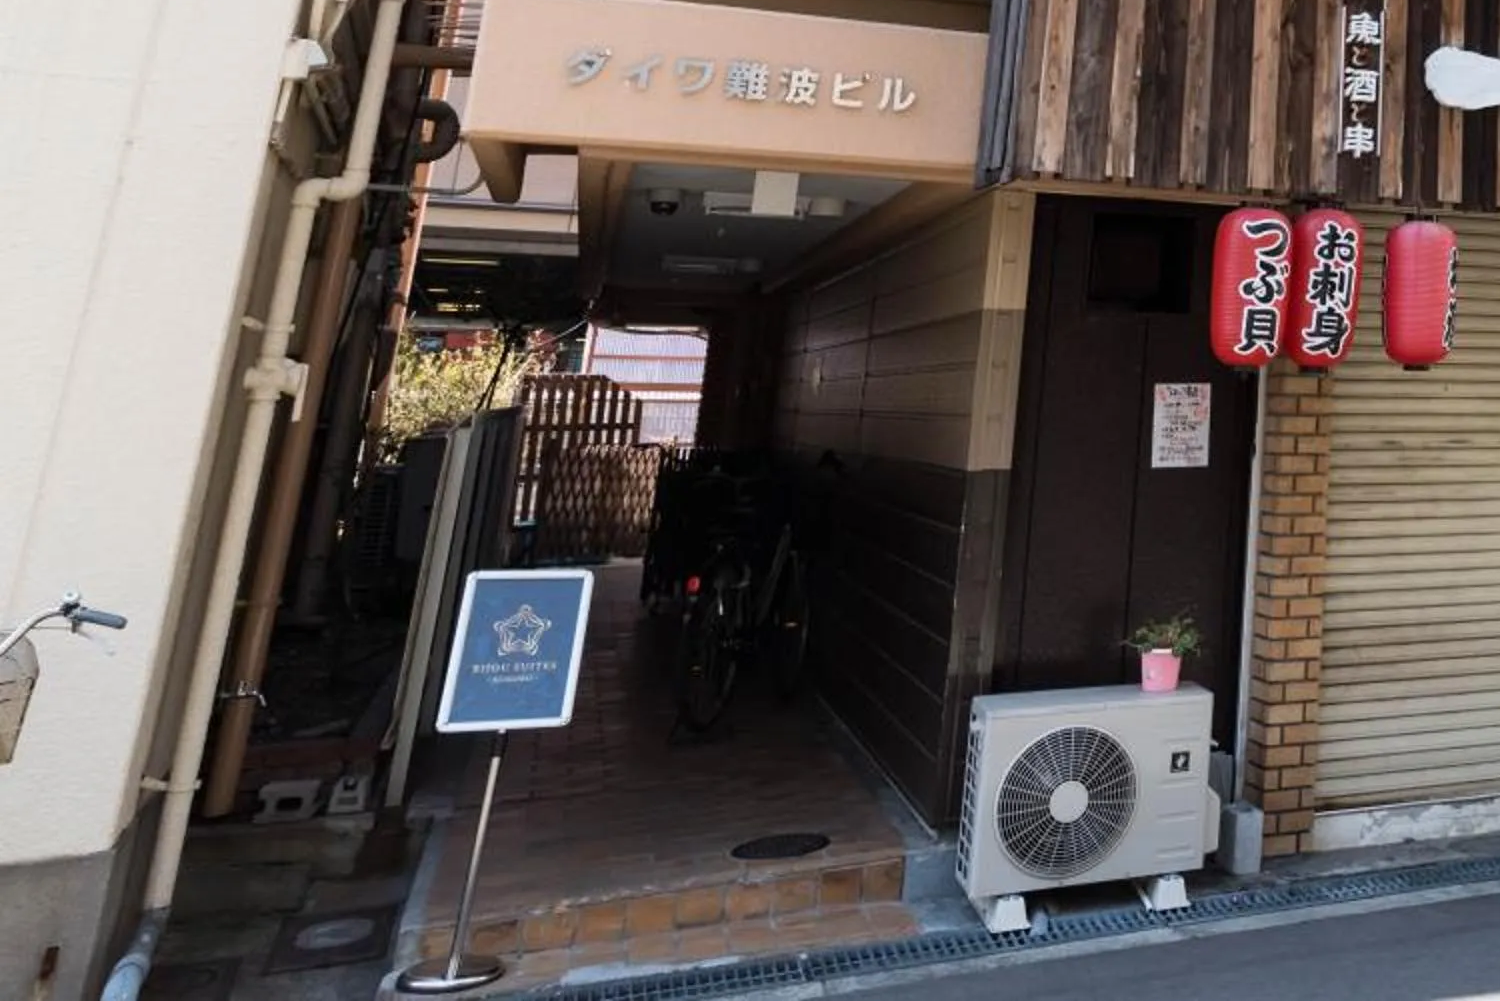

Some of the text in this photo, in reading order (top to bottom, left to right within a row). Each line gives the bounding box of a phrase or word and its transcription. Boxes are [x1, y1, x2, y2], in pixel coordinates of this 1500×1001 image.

[565, 46, 918, 115] ダイワ難波ビル
[1343, 10, 1384, 160] 魚と酒と串
[1235, 219, 1291, 356] つぶ貝
[1303, 221, 1357, 358] お刺身
